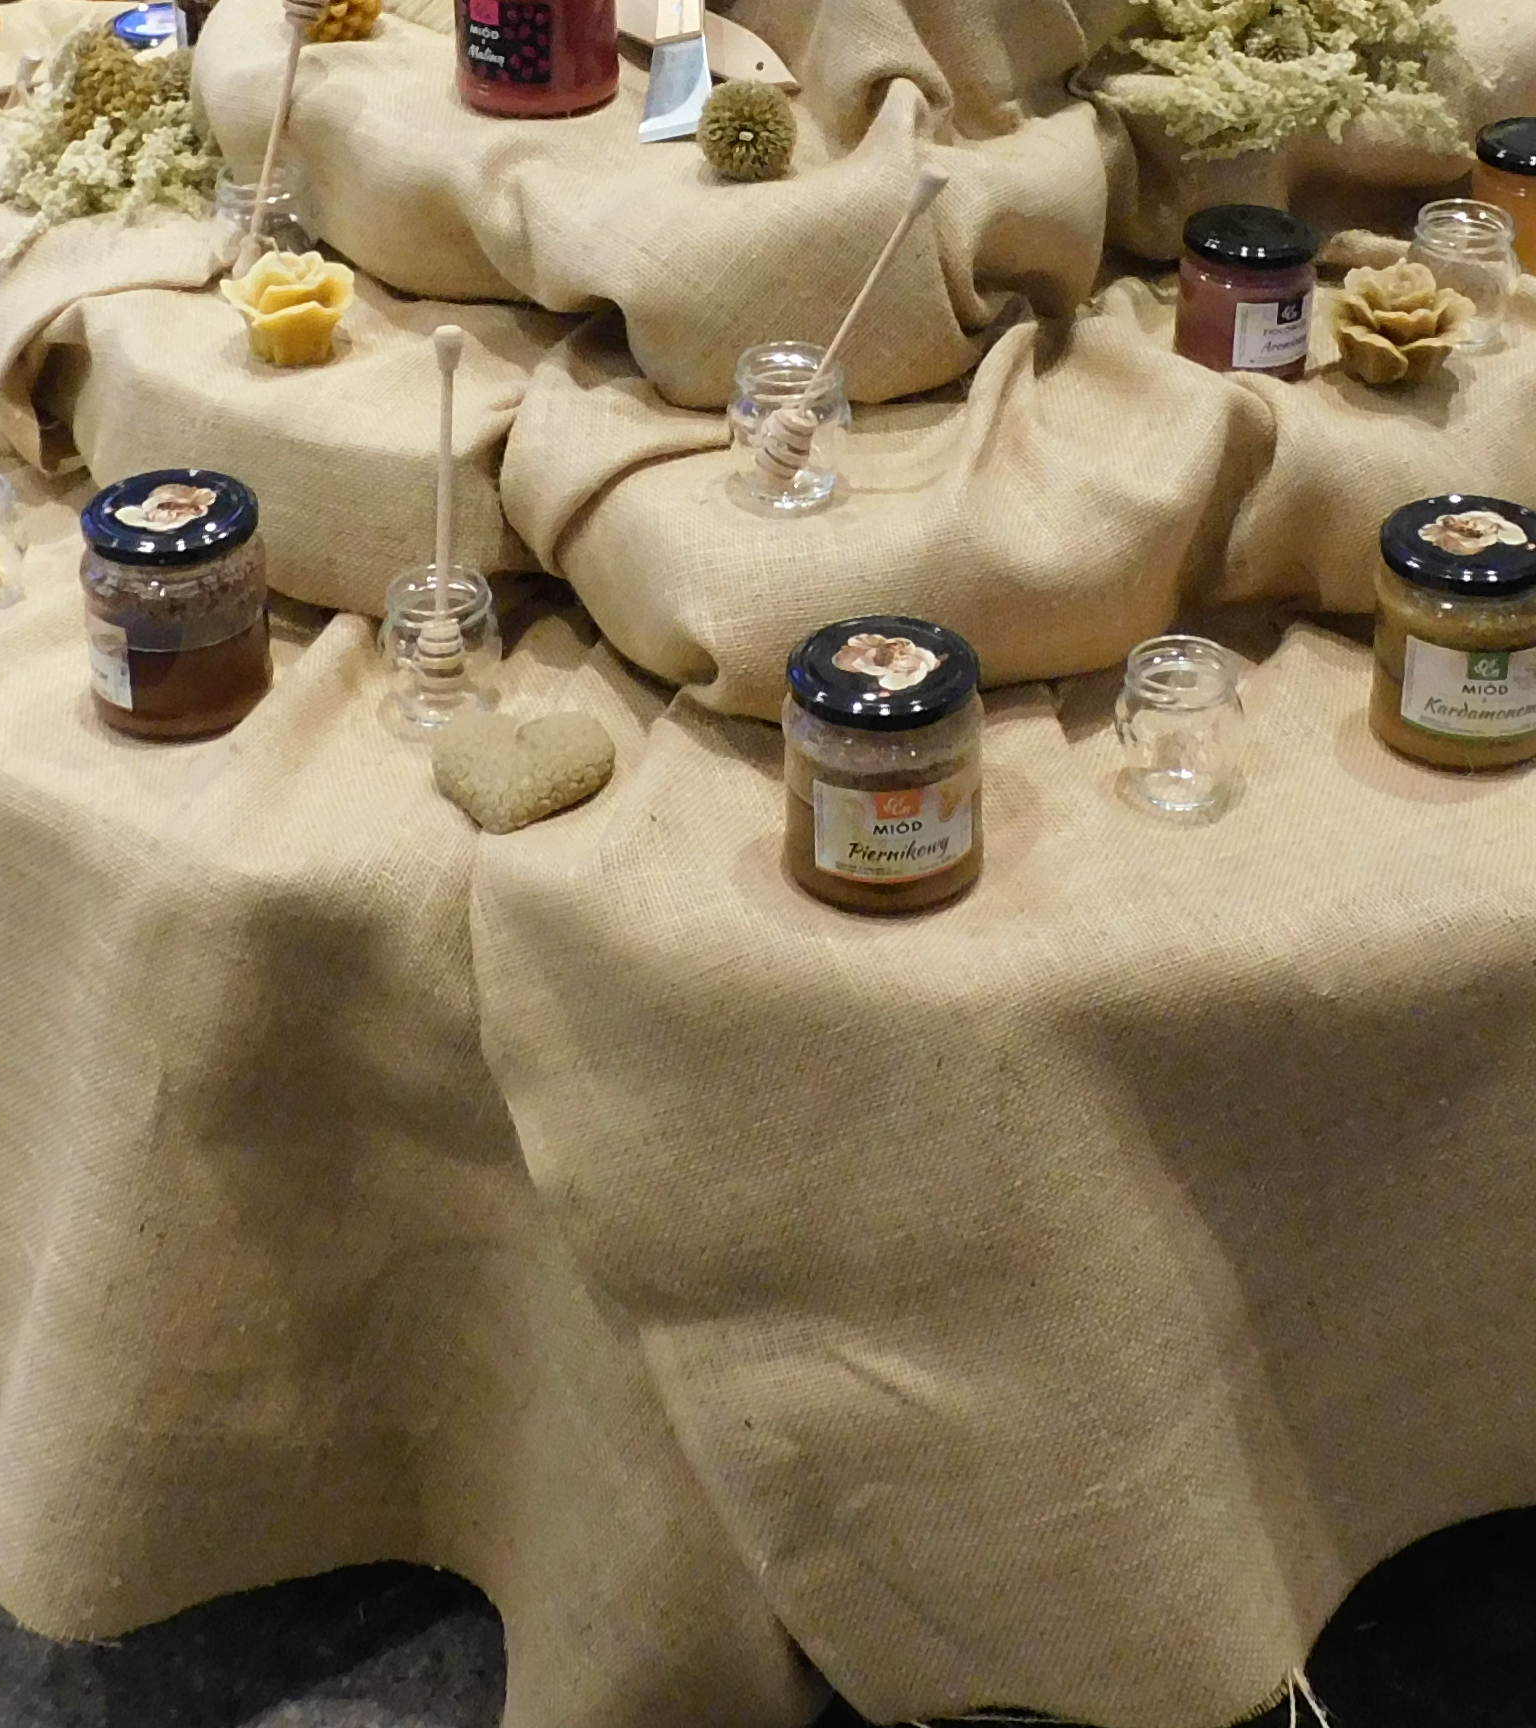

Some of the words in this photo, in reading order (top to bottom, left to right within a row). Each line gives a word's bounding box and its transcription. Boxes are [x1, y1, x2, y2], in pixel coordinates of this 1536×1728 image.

[1461, 683, 1510, 696] MIÓD
[872, 820, 924, 836] MIÓD
[847, 835, 951, 863] Piernikowy
